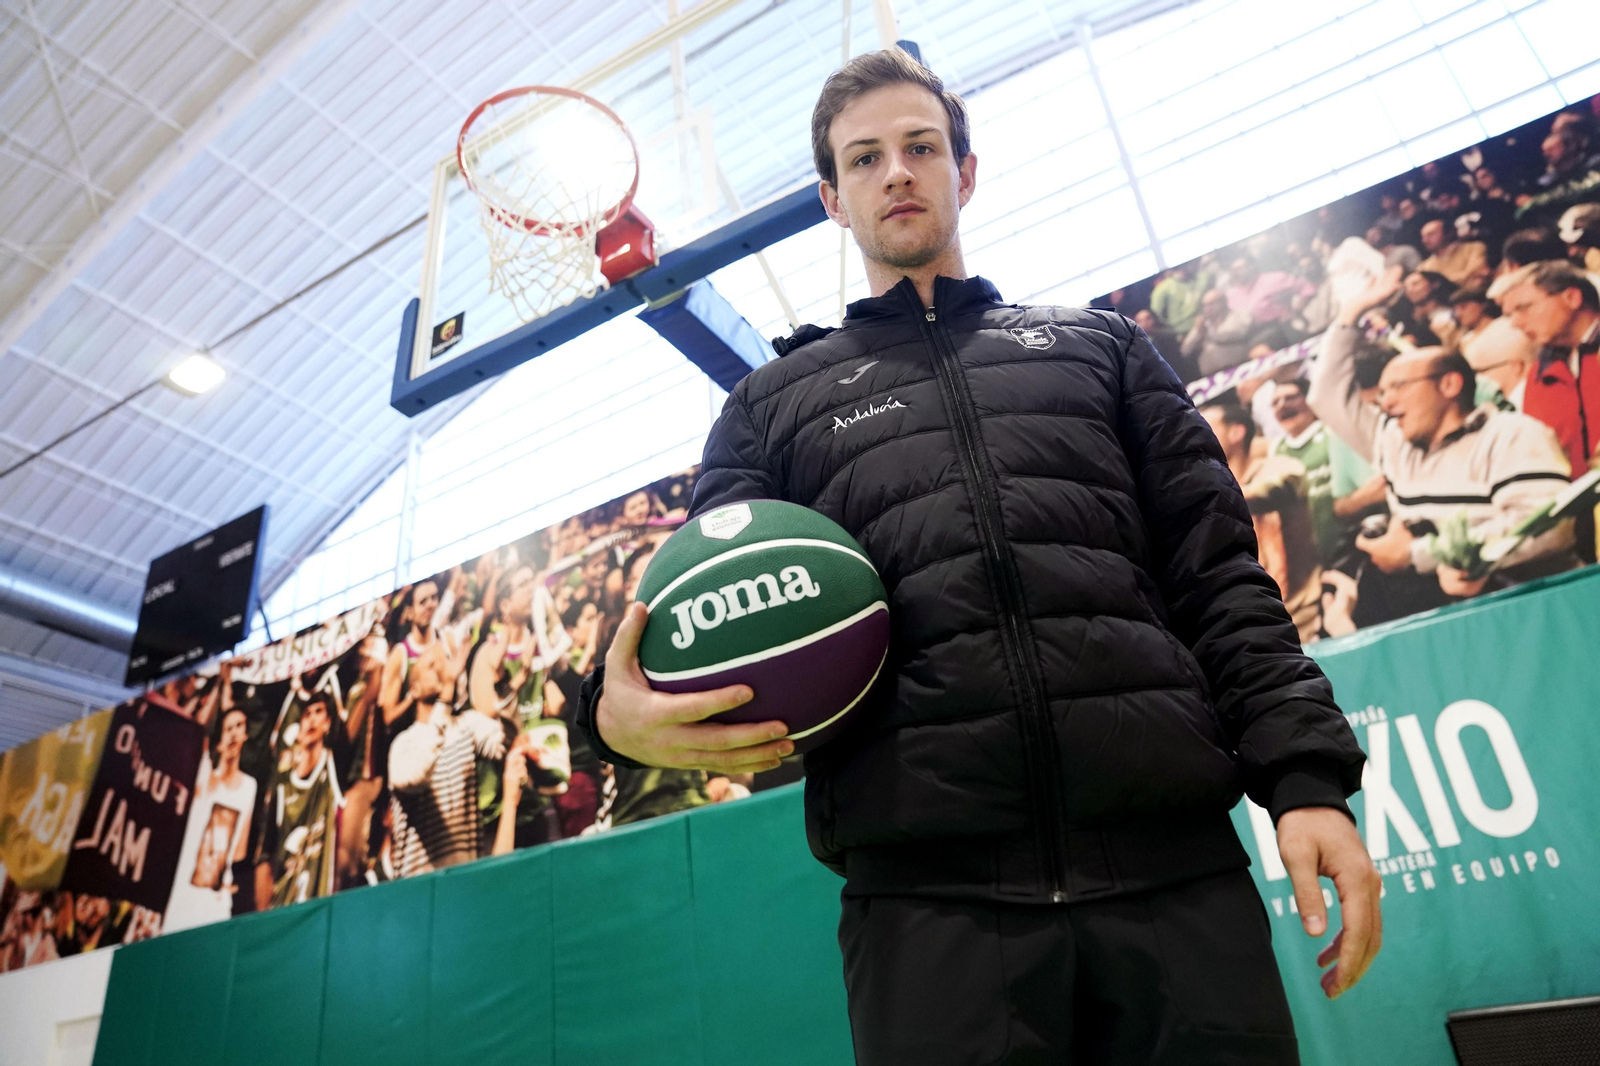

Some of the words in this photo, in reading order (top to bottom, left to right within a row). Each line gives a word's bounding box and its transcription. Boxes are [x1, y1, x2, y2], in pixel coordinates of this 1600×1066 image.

[832, 396, 908, 434] Andalucía
[1402, 869, 1437, 894] EN
[1451, 846, 1561, 885] EQUIPO
